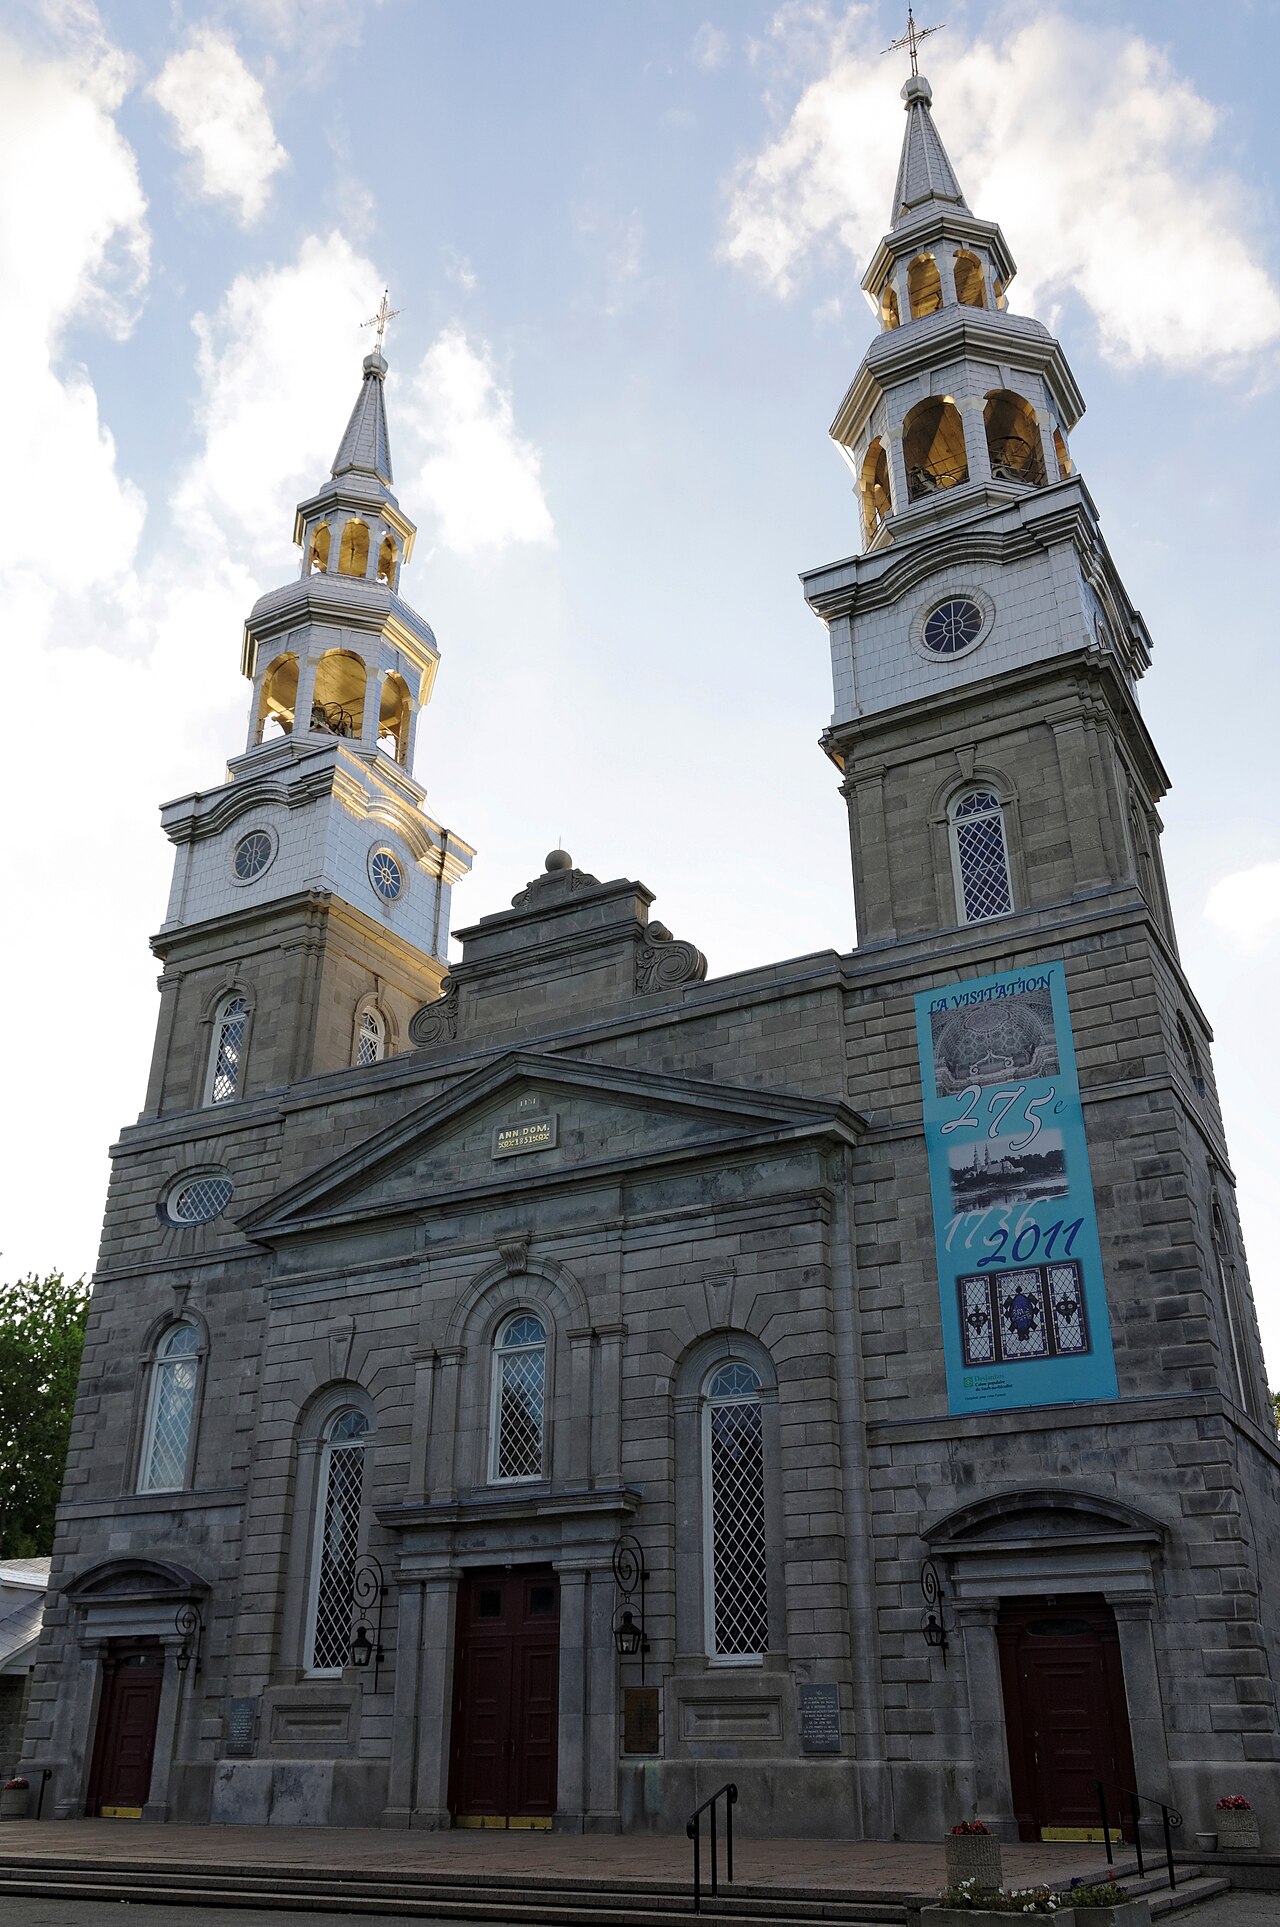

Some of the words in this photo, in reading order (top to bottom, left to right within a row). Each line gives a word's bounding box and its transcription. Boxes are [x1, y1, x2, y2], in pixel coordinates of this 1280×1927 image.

[928, 999, 949, 1015] LA
[951, 970, 1055, 1007] VISITATION
[943, 1196, 1051, 1253] 1736
[976, 1217, 1085, 1268] 2011
